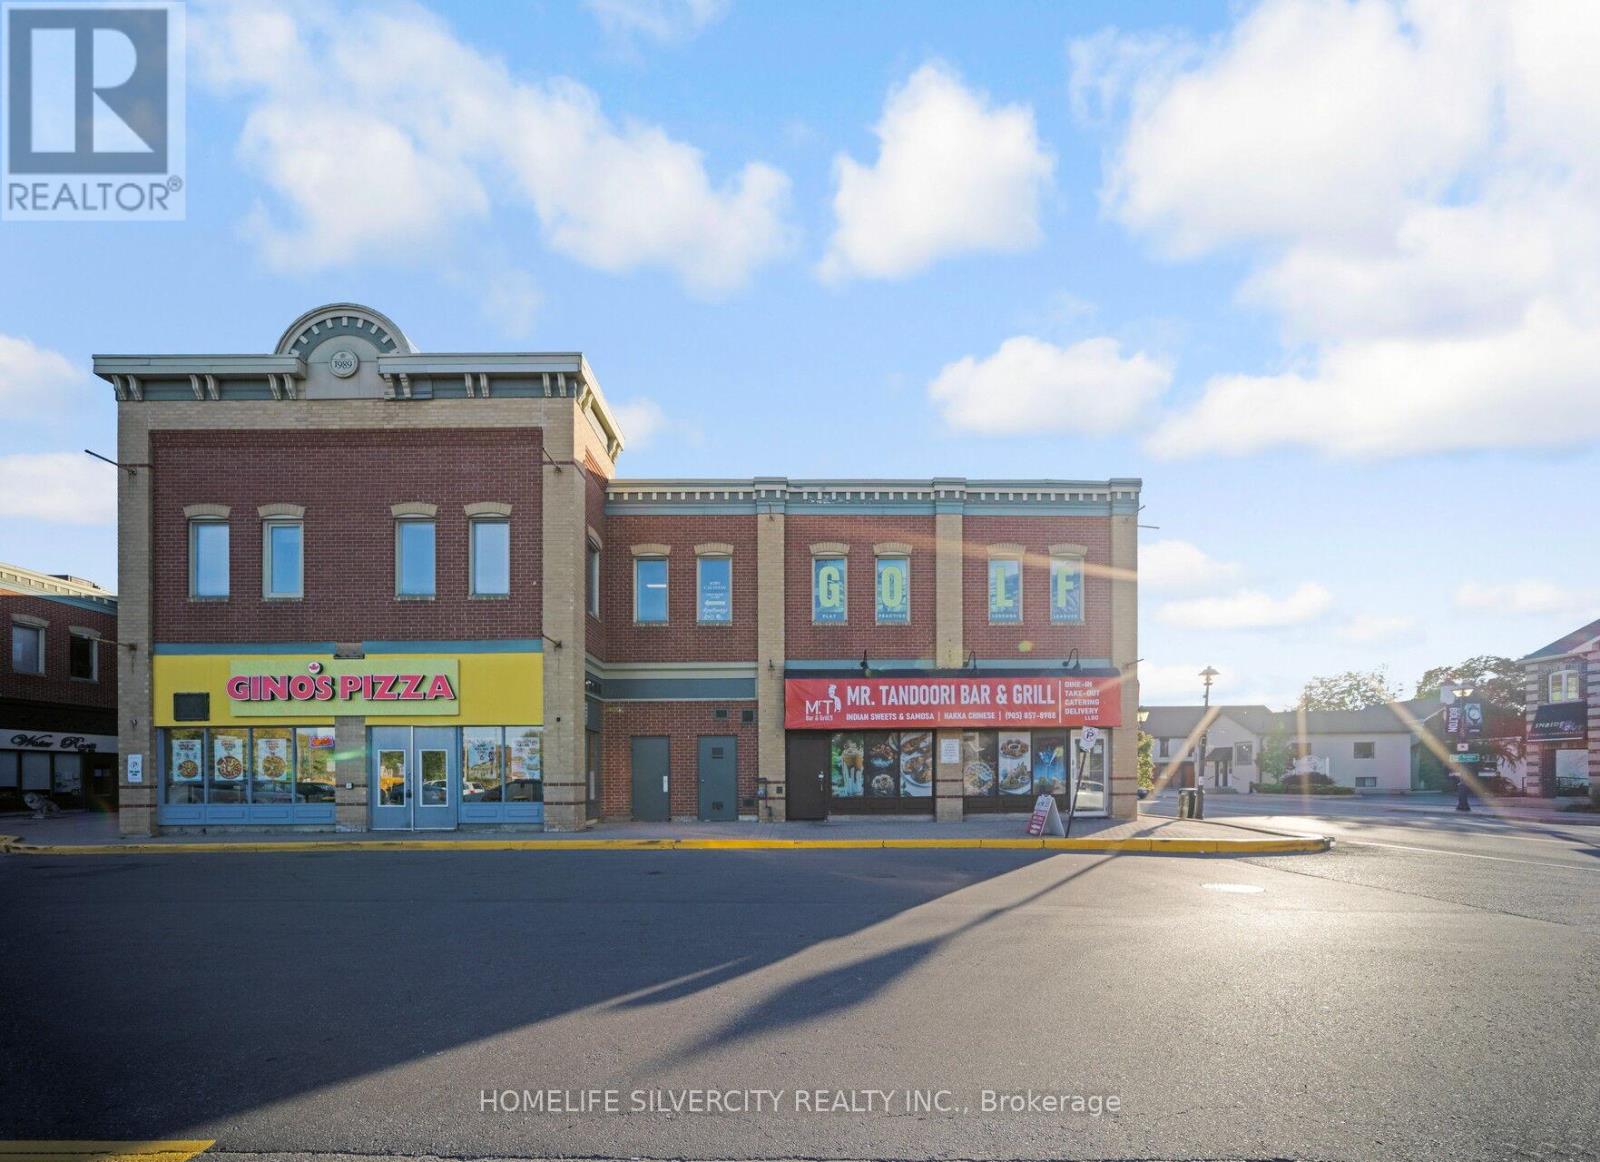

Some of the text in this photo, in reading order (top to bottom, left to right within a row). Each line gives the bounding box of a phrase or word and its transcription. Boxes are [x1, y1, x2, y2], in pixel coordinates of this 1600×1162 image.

[333, 360, 353, 370] 1989
[338, 673, 456, 701] PIZZA
[1064, 680, 1093, 688] DINE-IN
[846, 684, 1056, 706] MR. TANDOORI BAR & GRILL
[1064, 689, 1100, 697] TAKE-OUT
[1064, 698, 1100, 706] CATERING
[846, 712, 869, 721] INDIAN
[869, 712, 898, 721] SWEETS
[898, 712, 904, 720] &
[905, 712, 935, 720] SAMOSA
[944, 712, 967, 720] HAKKA
[968, 711, 996, 720] CHINESE
[1005, 711, 1022, 720] (905)
[1064, 707, 1099, 715] DELIVERY
[1448, 707, 1459, 733] BOLTON
